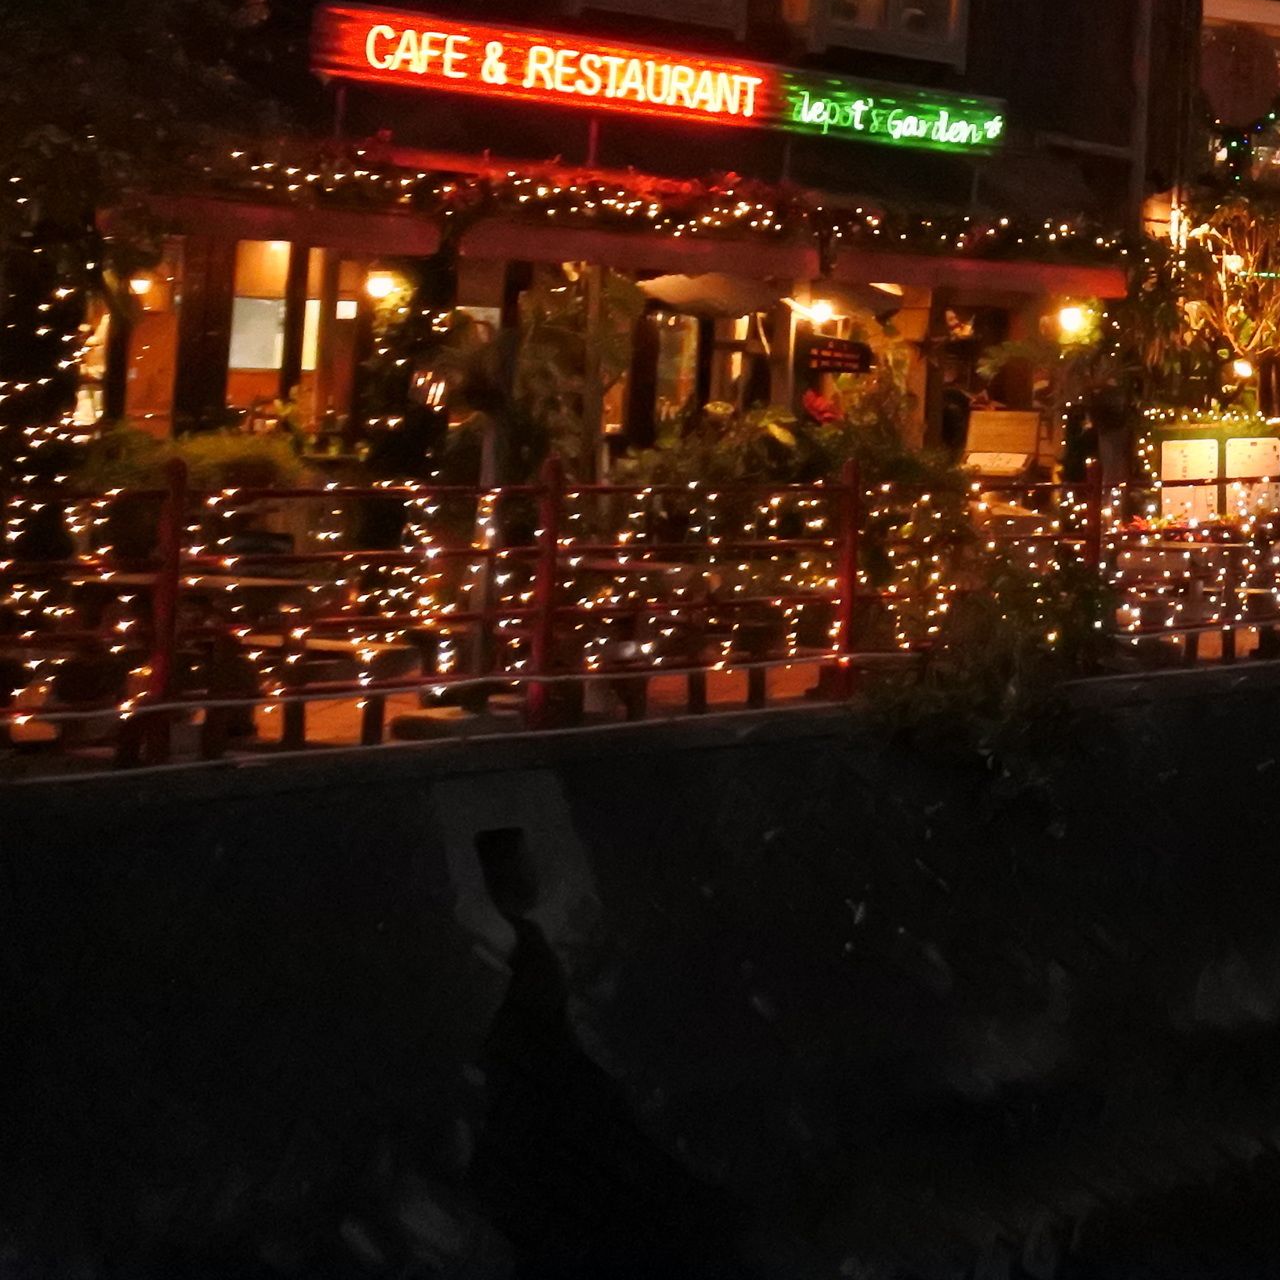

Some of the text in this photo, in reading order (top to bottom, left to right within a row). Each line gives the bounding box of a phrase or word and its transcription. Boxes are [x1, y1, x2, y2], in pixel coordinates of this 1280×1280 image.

[366, 25, 762, 117] CAFE & RESTAURANT
